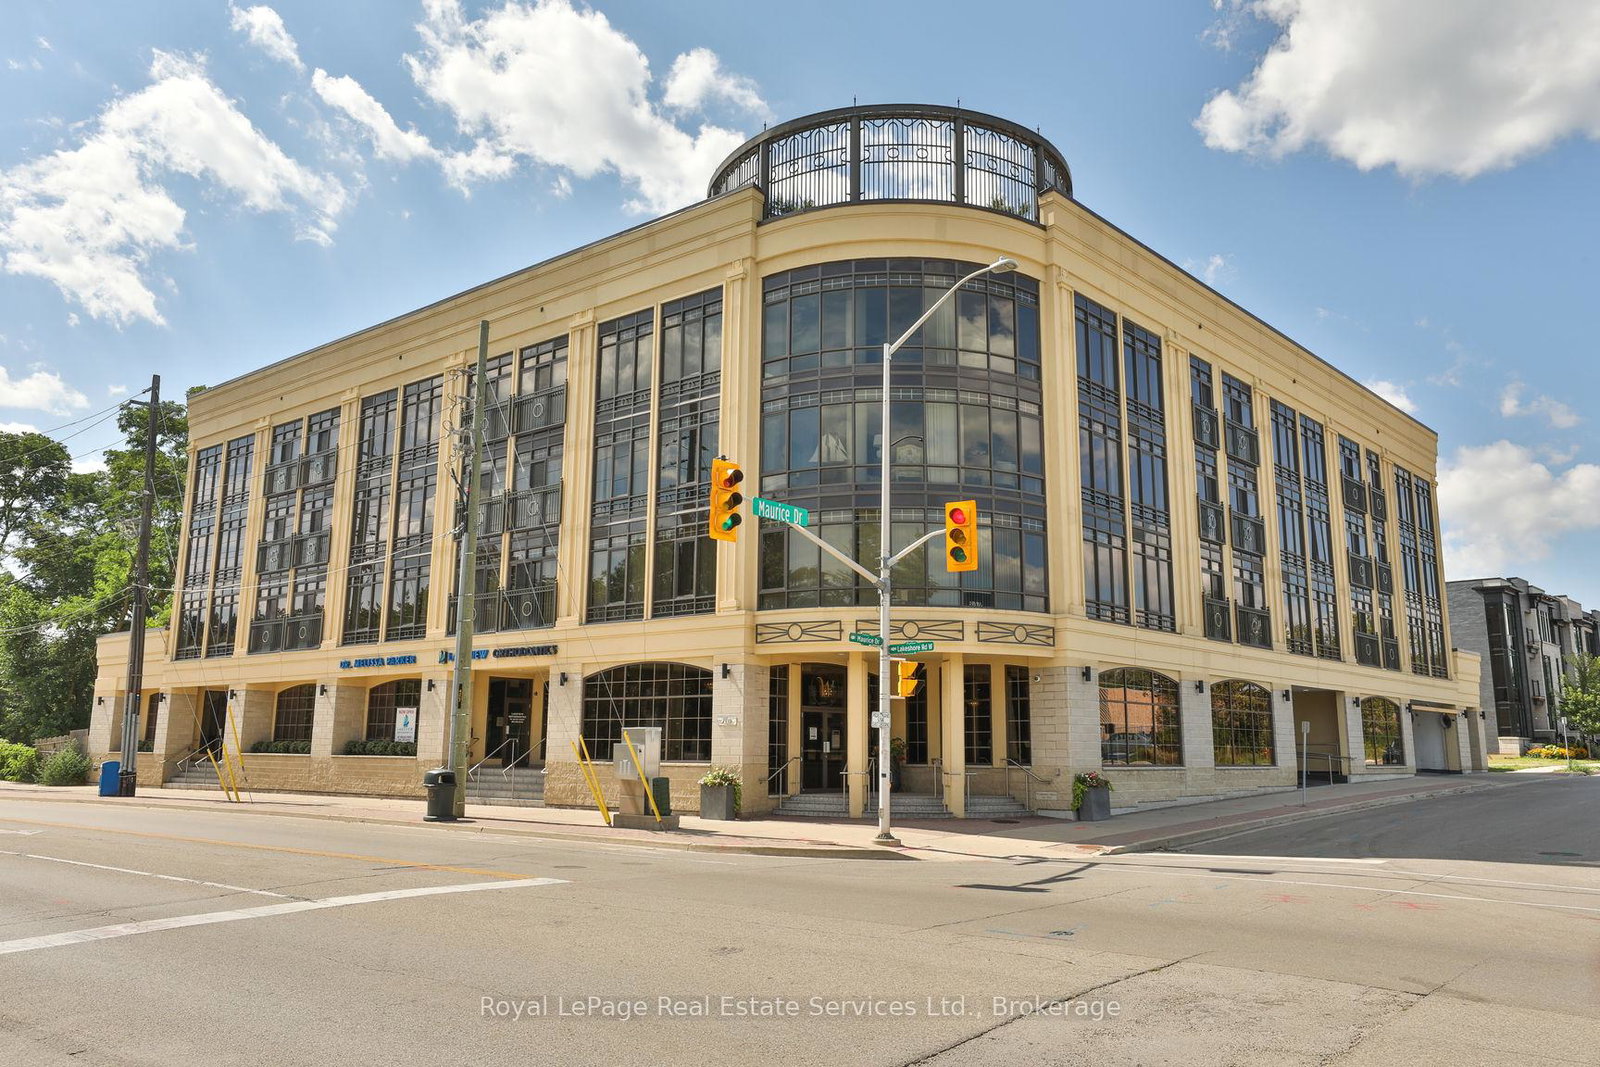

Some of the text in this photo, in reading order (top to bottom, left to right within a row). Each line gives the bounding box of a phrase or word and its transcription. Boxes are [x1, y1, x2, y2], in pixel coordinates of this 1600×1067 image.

[758, 500, 803, 525] Maurice Dr
[857, 635, 874, 645] Maurice
[492, 644, 558, 658] ORTHODONTICS
[897, 644, 921, 652] Lakeshore
[354, 657, 385, 668] MELISSA
[386, 655, 417, 666] PARKER
